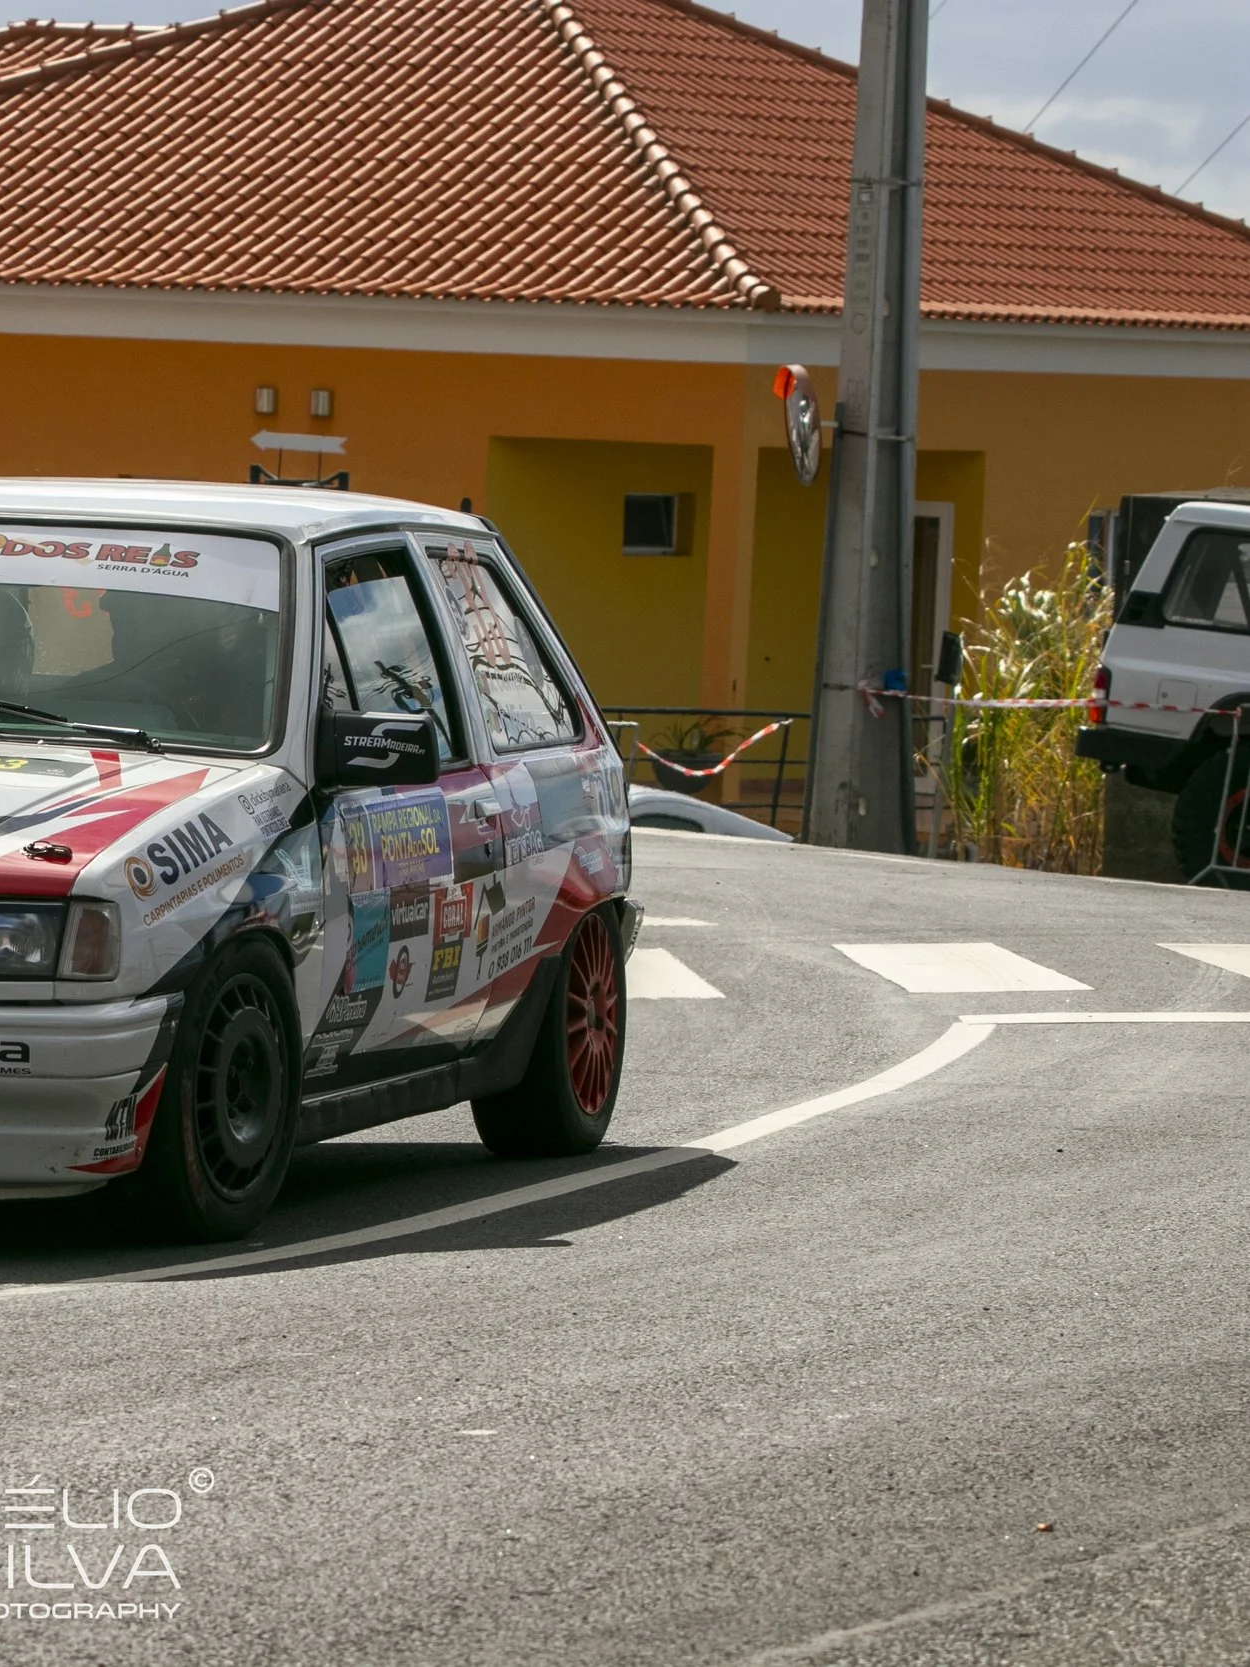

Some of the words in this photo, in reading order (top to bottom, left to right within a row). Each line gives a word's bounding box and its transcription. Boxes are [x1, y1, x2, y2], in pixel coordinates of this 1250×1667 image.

[0, 540, 93, 559] DOS
[97, 563, 138, 573] SERRA
[141, 566, 190, 578] D'ÁGUA
[398, 804, 434, 829] REGIONAL
[147, 812, 234, 885] SIMA
[351, 822, 368, 874] 33
[421, 827, 440, 855] SOL
[144, 882, 199, 927] CARPINTARIAS
[203, 855, 245, 888] POLIMENTOS
[443, 903, 464, 929] CORAL
